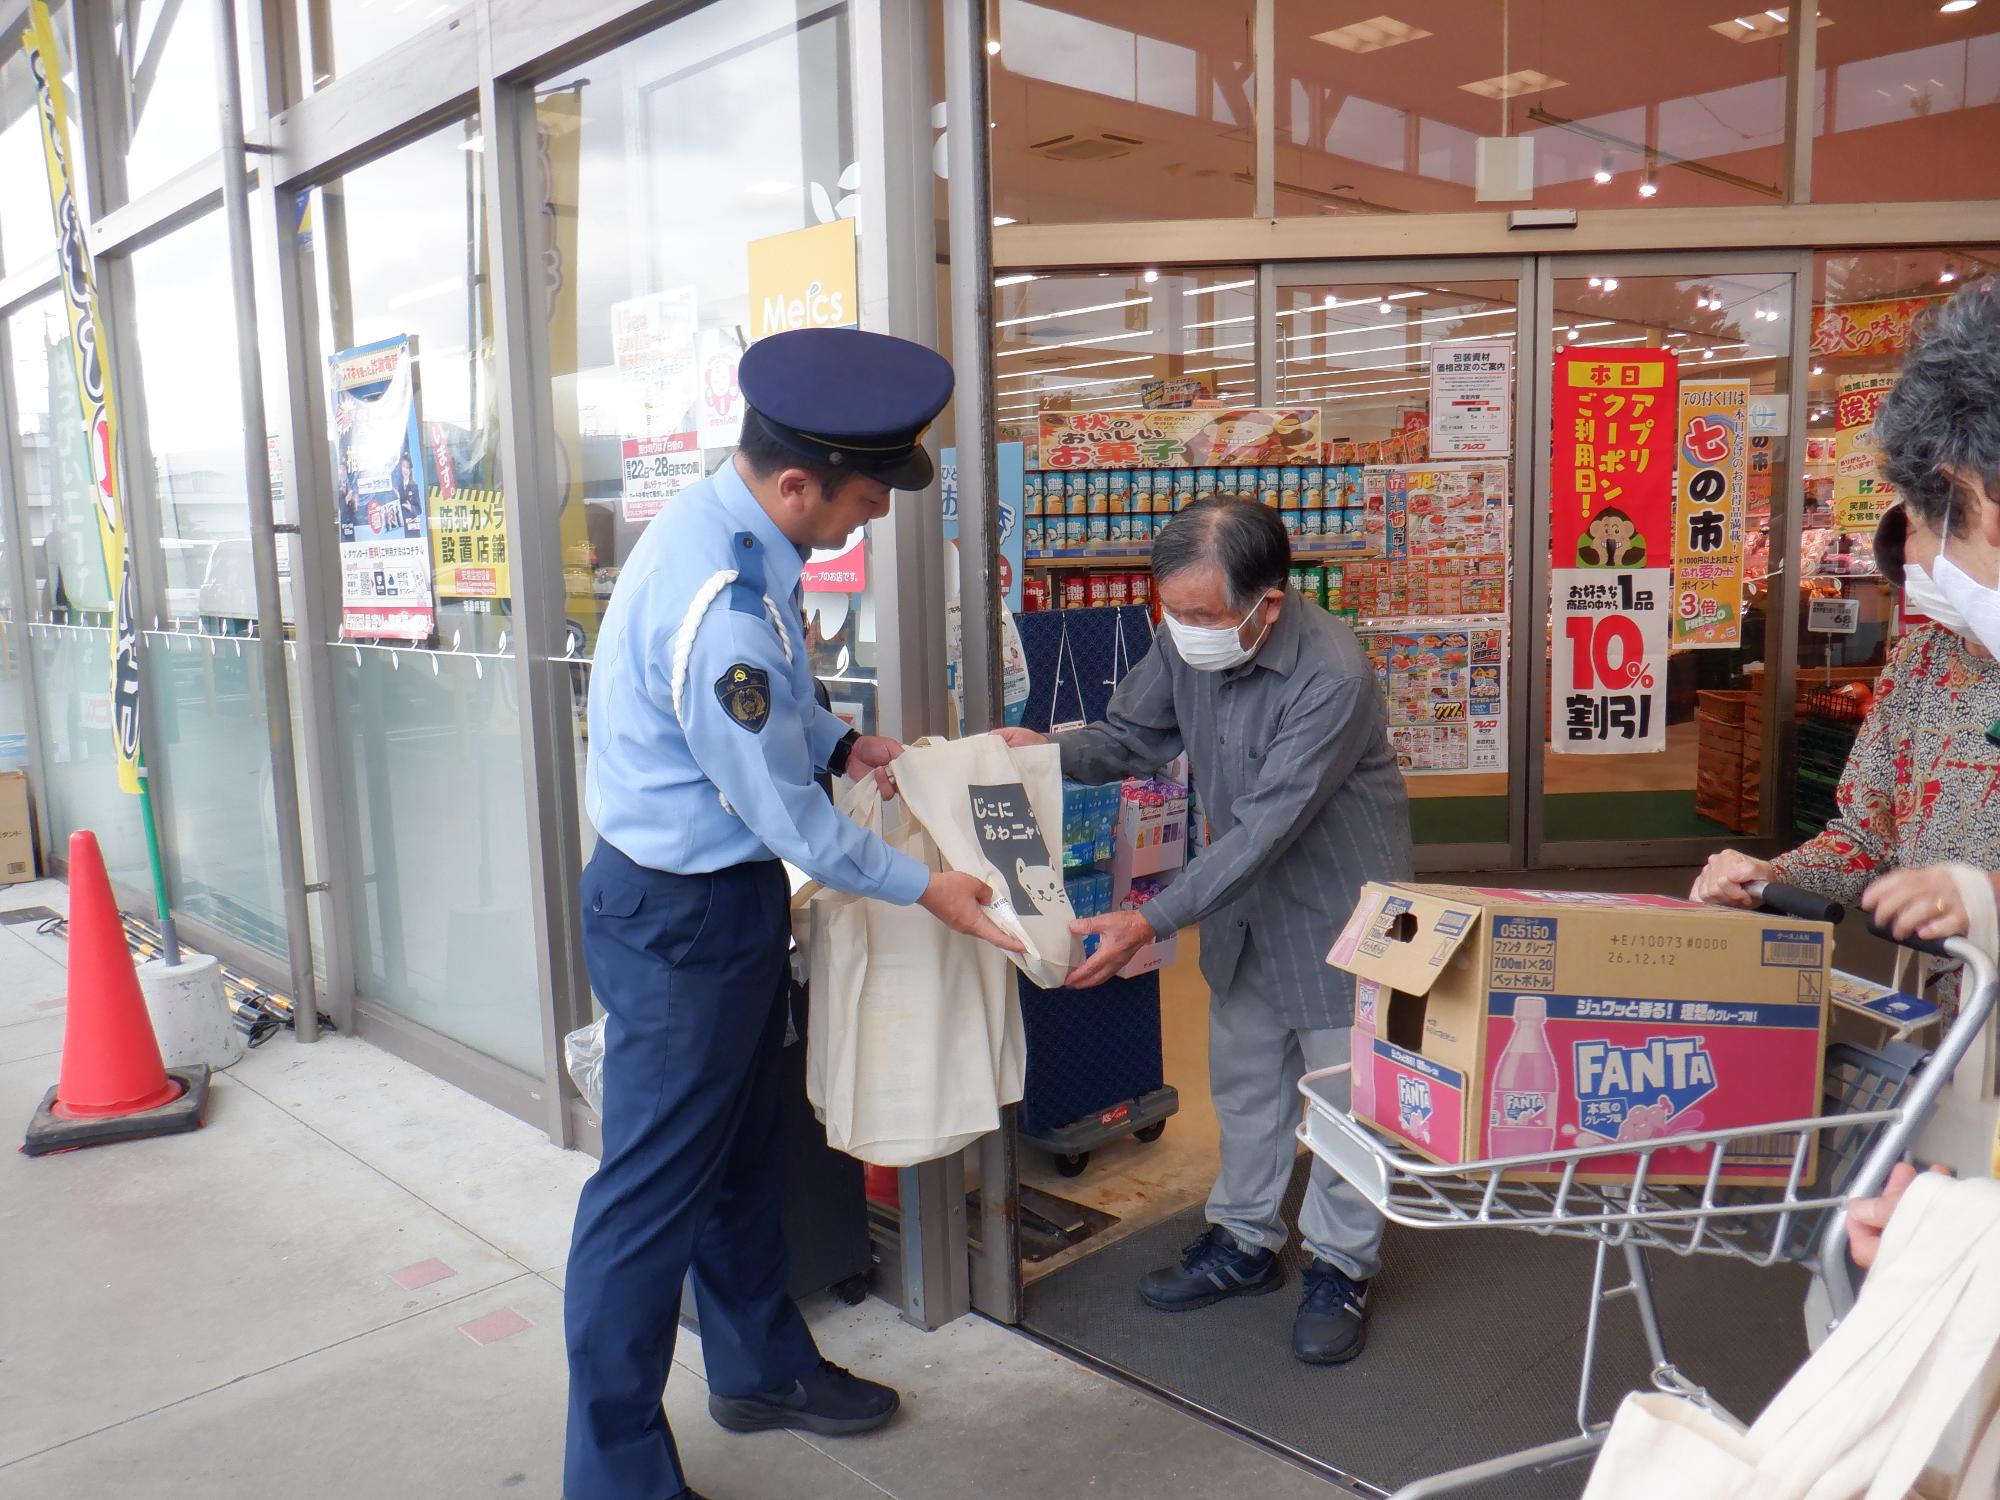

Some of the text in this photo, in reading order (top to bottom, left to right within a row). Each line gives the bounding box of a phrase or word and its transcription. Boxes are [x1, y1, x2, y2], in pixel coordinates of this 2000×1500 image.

[1453, 352, 1490, 363] 包装資材
[1436, 362, 1506, 373] 価格改定のご案内
[1589, 364, 1641, 386] 本日
[1683, 390, 1745, 407] 7の付く日は
[1071, 414, 1131, 432] 秋の
[1061, 429, 1163, 445] おいしい
[1630, 394, 1655, 473] アプリ
[1050, 439, 1186, 466] お菓子
[1574, 392, 1598, 518] ご利用日!
[1598, 394, 1627, 501] クーポン
[1840, 454, 1868, 467] ありがとう
[1684, 415, 1731, 553] 七の市
[440, 503, 504, 533] 防犯カメラ
[441, 534, 506, 564] 設置店舗
[1680, 564, 1735, 580] ふれ愛カード
[1067, 585, 1085, 593] chip
[1109, 582, 1127, 591] chip
[1109, 590, 1127, 598] star
[1569, 584, 1618, 598] お好きな
[1617, 574, 1655, 611] 1品
[1681, 580, 1719, 591] ポイント
[1067, 592, 1085, 601] star
[1566, 599, 1619, 611] 商品の中から
[1679, 590, 1719, 620] 3倍
[1834, 614, 1852, 625] 68
[1565, 613, 1655, 691] 10%
[1565, 693, 1652, 741] 割引
[973, 797, 1014, 819] じこに
[1500, 923, 1549, 939] 055150
[1495, 940, 1554, 954] ファンタ グレープ
[1607, 951, 1676, 966] 26.12.12
[1493, 974, 1552, 988] ペットボトル
[1575, 998, 1759, 1023] ジュワッと香る! 理想のグレープ味!
[1577, 1040, 1713, 1096] FANTA
[1400, 1078, 1431, 1109] FANTA
[1505, 1093, 1544, 1110] FANTA
[1587, 1102, 1621, 1115] 本気の
